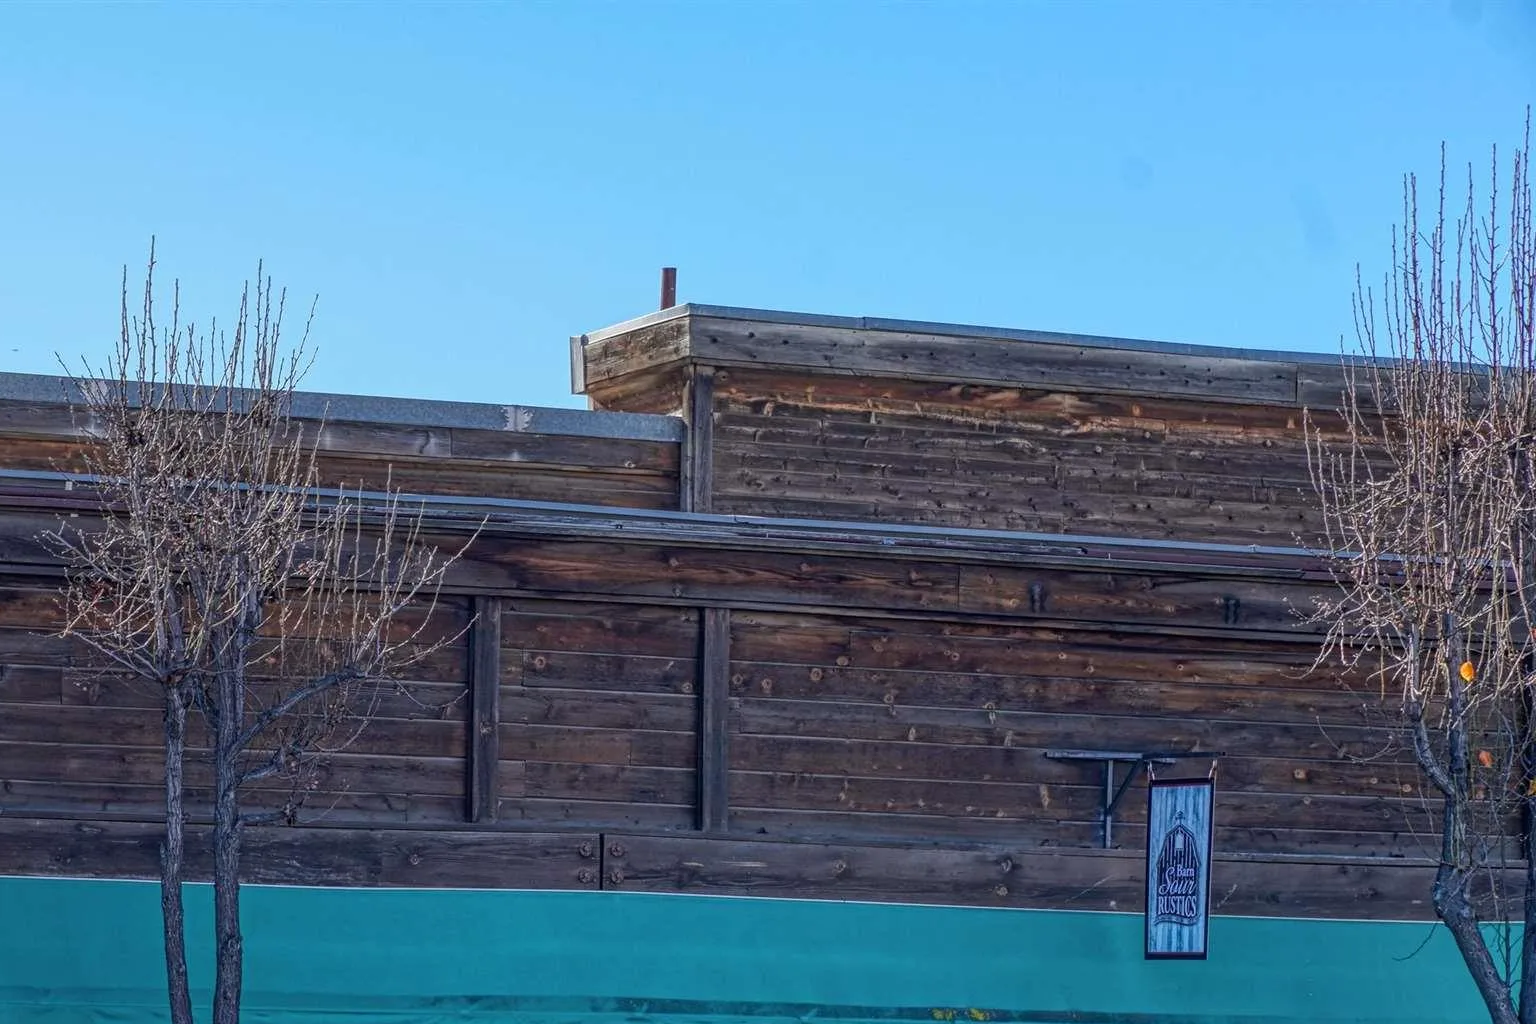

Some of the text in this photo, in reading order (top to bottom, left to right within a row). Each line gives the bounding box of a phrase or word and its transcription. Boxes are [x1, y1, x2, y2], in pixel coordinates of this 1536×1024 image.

[1158, 866, 1197, 895] Sour
[1177, 864, 1194, 877] Barn
[1158, 895, 1197, 917] RUSTICS
